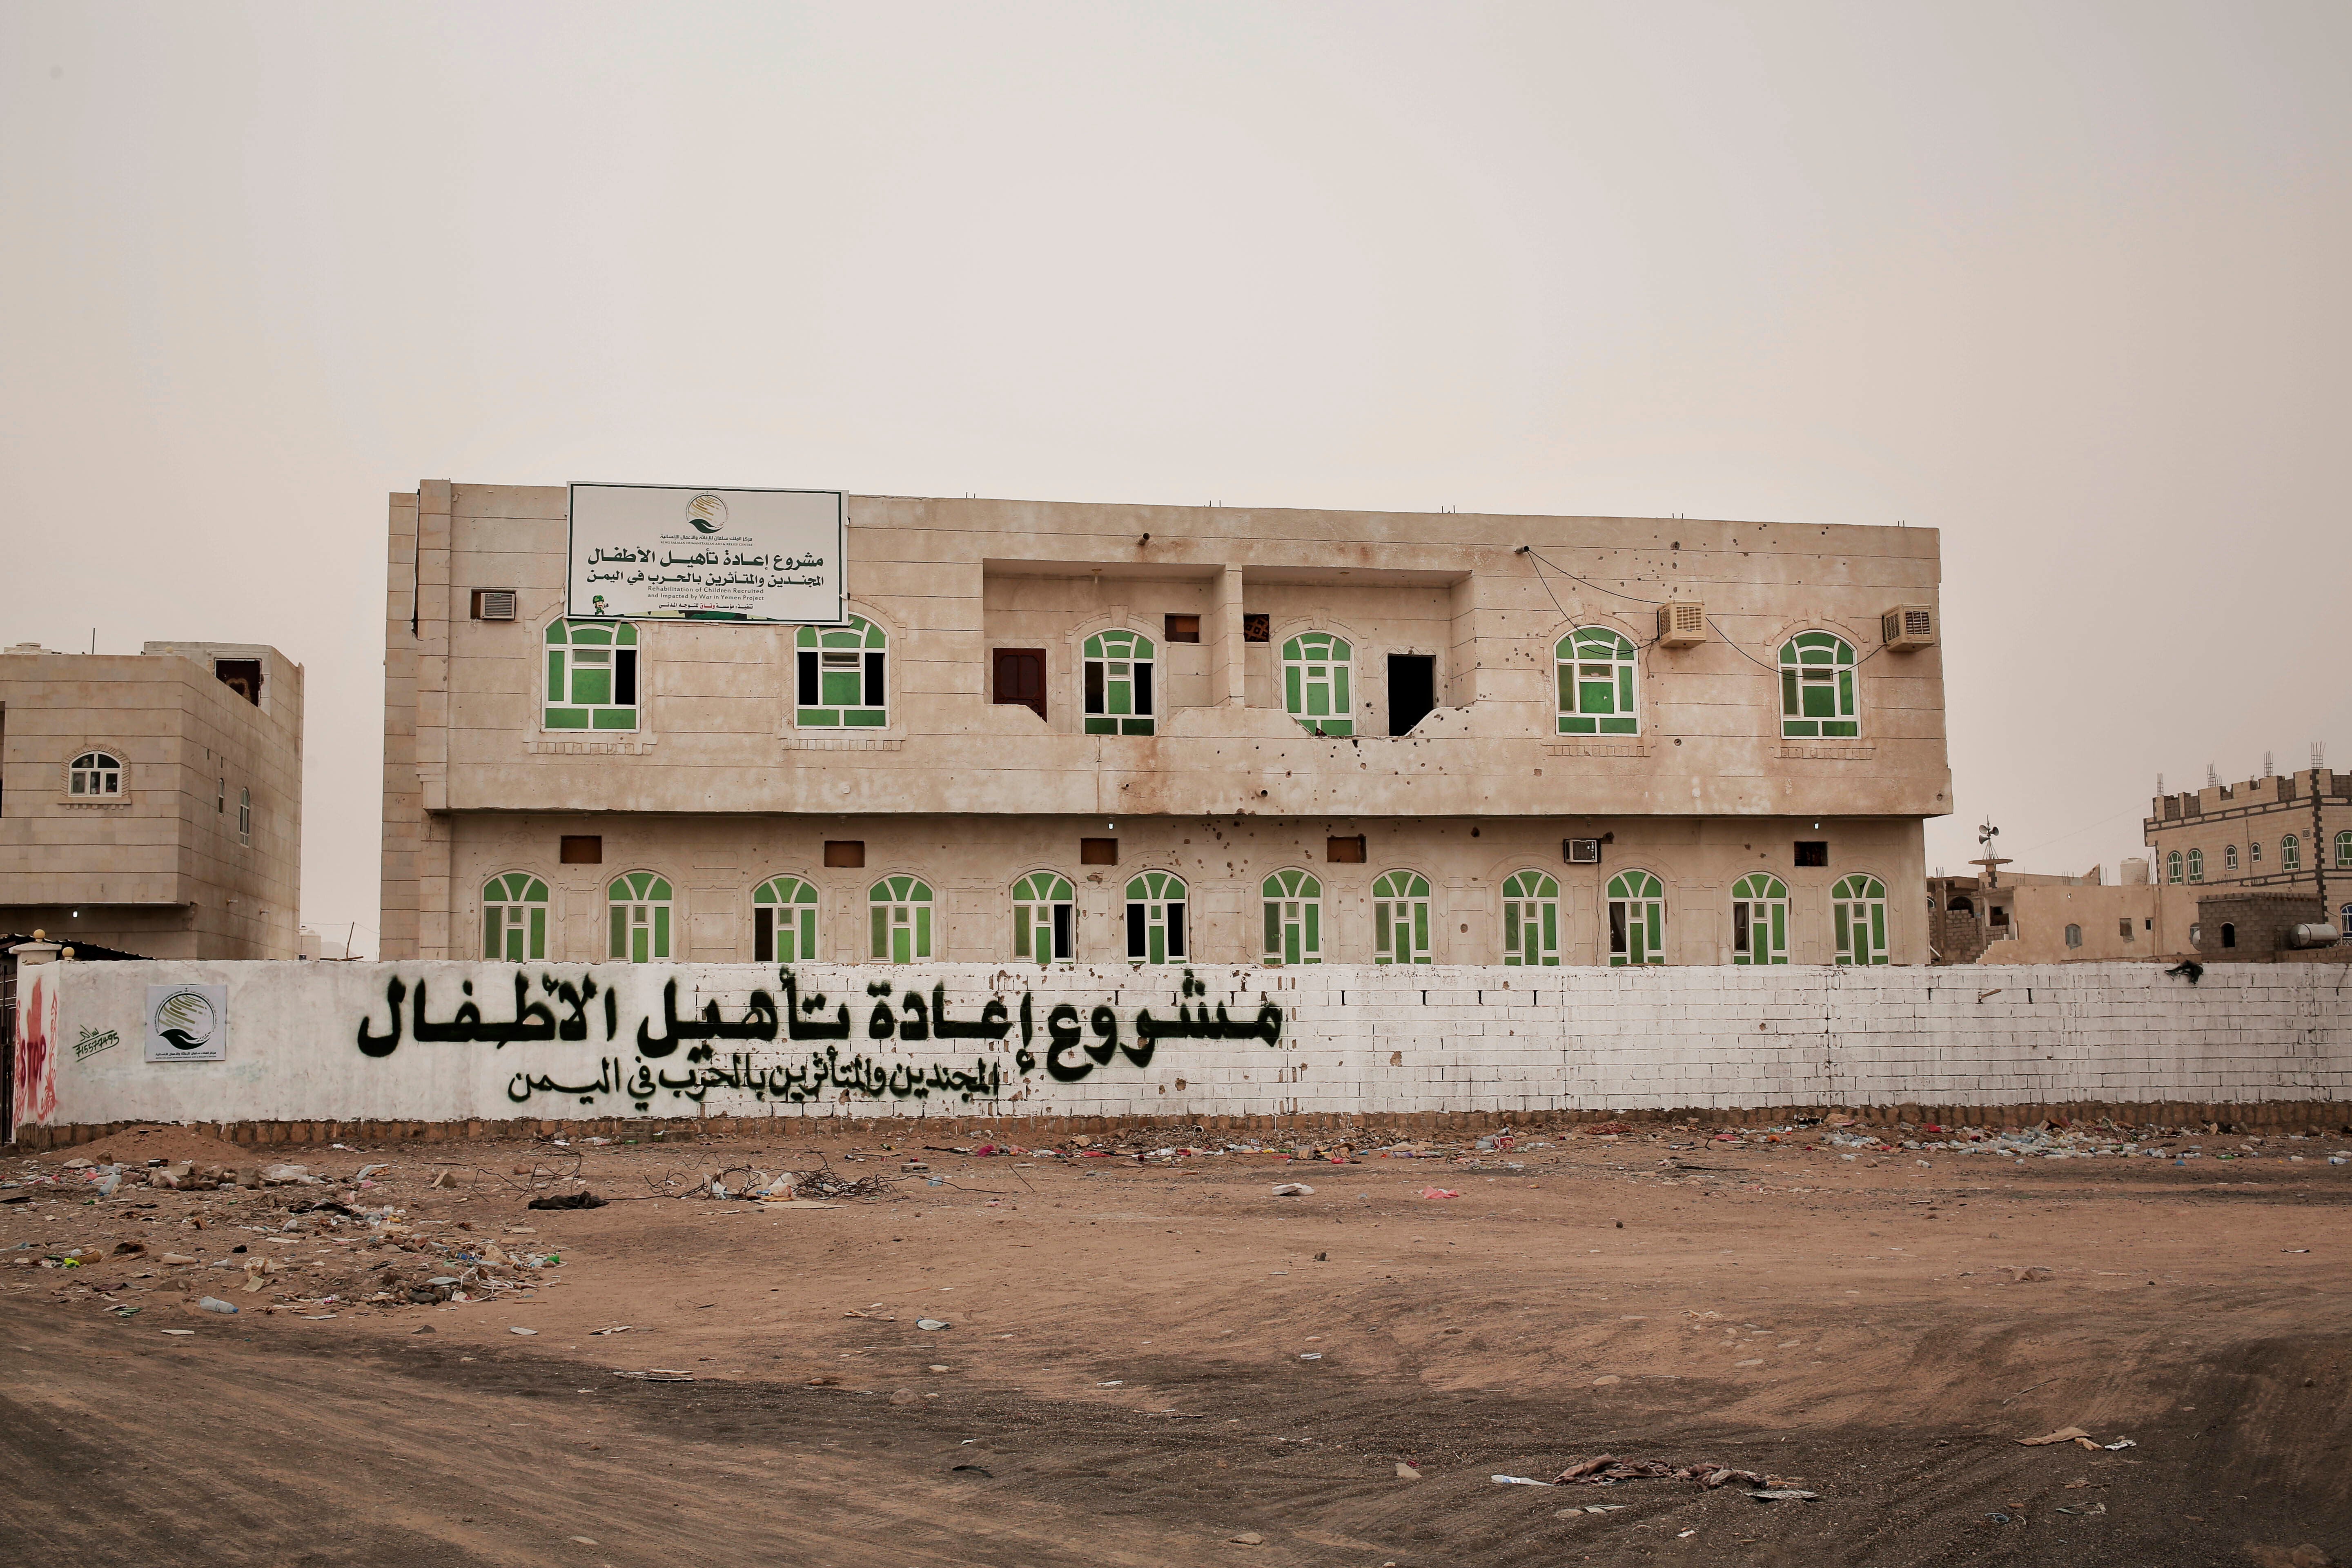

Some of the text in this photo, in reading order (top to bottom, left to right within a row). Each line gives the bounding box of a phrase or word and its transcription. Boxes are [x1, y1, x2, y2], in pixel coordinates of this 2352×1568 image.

[588, 546, 824, 571] مشروع إعادة تأهيل الأطفال
[586, 569, 824, 588] المجندين والمتأثرين بالحرب في اليمن
[357, 965, 1283, 1082] مشروع إعادة تأهيل الأطفال
[21, 1034, 46, 1088] STOP
[76, 1032, 119, 1057] 715577495
[508, 1045, 999, 1111] المجندين والمتأثرين بالحرب في اليمن
